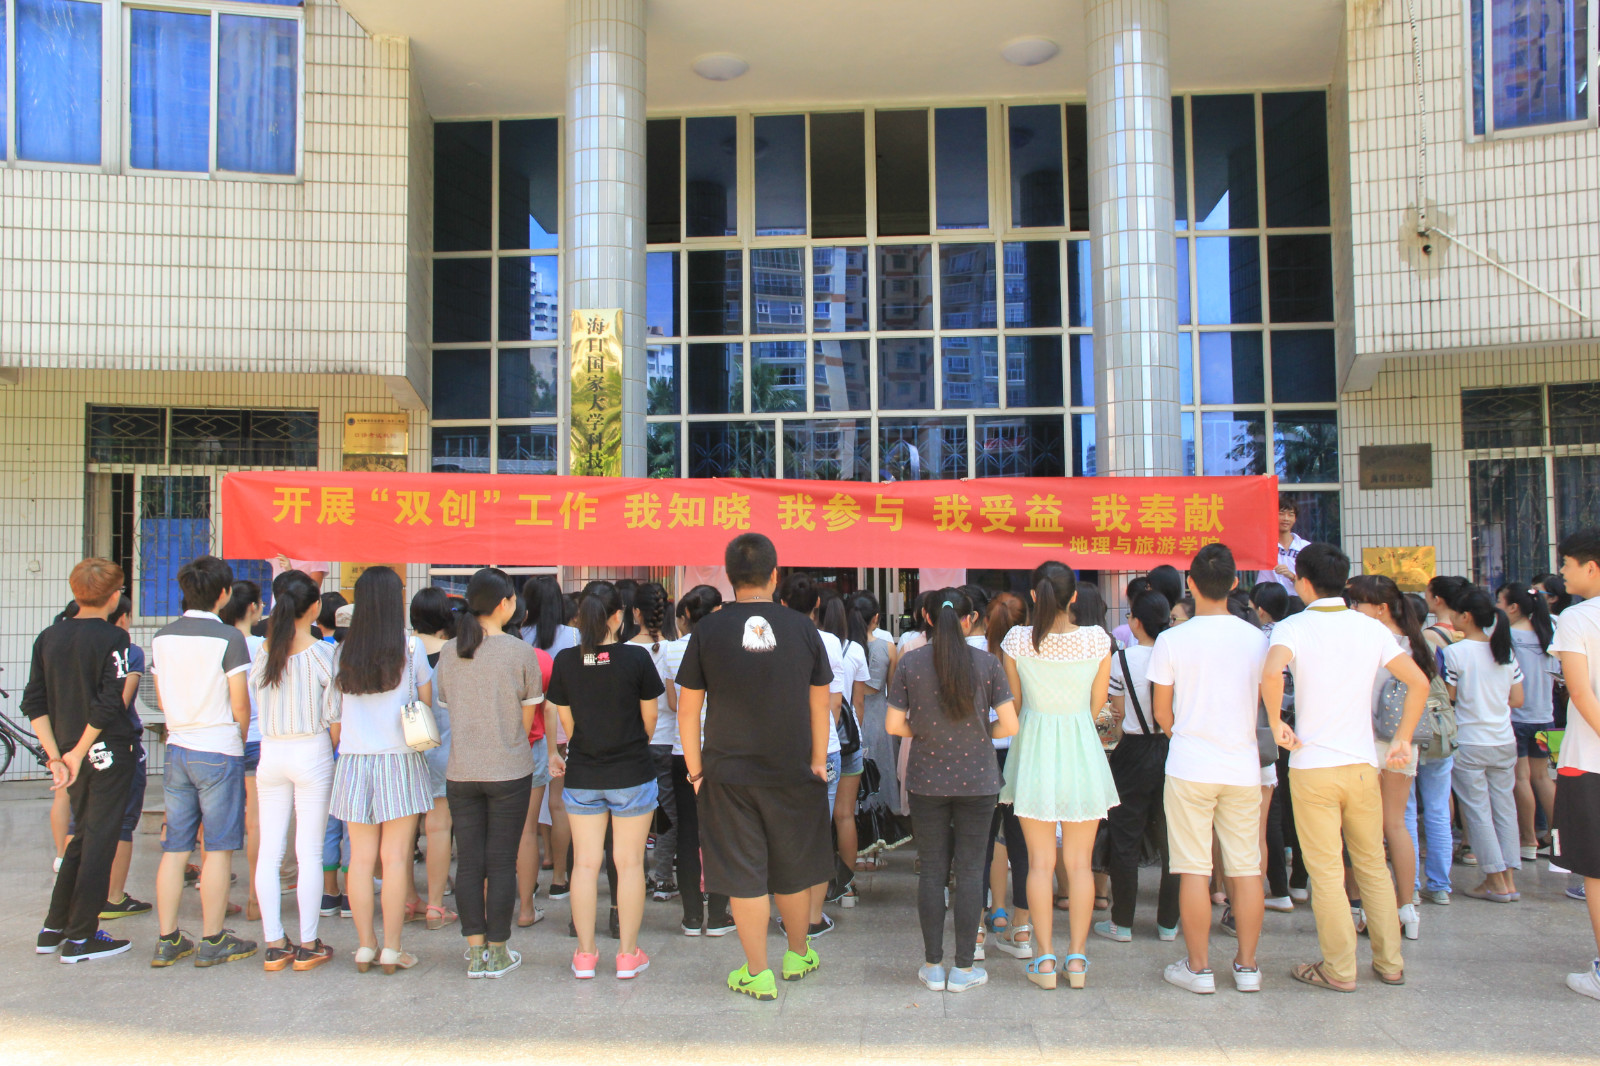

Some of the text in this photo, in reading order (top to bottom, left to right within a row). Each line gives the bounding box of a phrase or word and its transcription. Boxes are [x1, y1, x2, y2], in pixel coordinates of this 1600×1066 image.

[586, 316, 606, 477] 海口国家大学科技
[624, 492, 750, 529] 我知晓
[777, 493, 905, 531] 我参与
[933, 493, 1064, 532] 我受益
[1091, 493, 1225, 532] 我奉献
